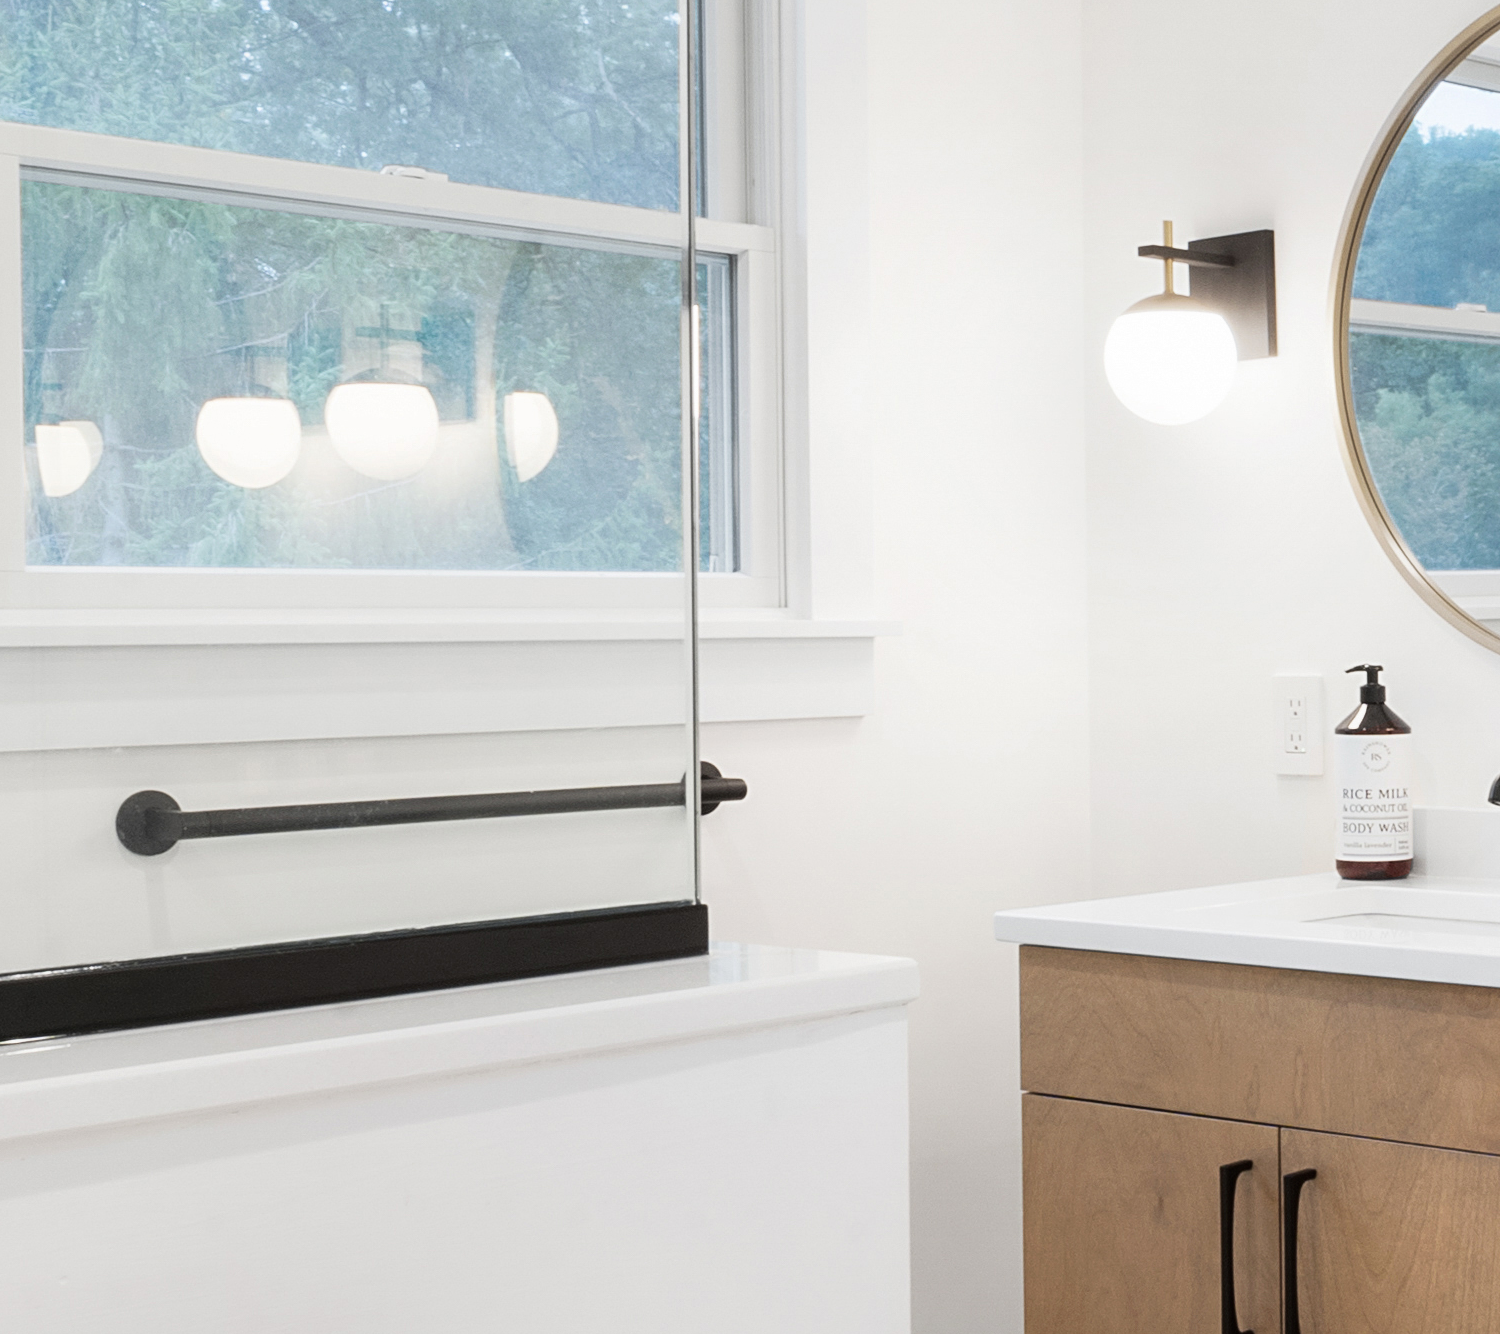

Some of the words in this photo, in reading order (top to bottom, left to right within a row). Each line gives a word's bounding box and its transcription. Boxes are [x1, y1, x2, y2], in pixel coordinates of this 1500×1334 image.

[1342, 788, 1373, 800] RICE
[1378, 788, 1408, 799] MILK
[1349, 804, 1397, 813] COCONUT
[1397, 803, 1408, 812] OIL
[1342, 822, 1374, 833] BODY
[1378, 821, 1409, 833] WASH
